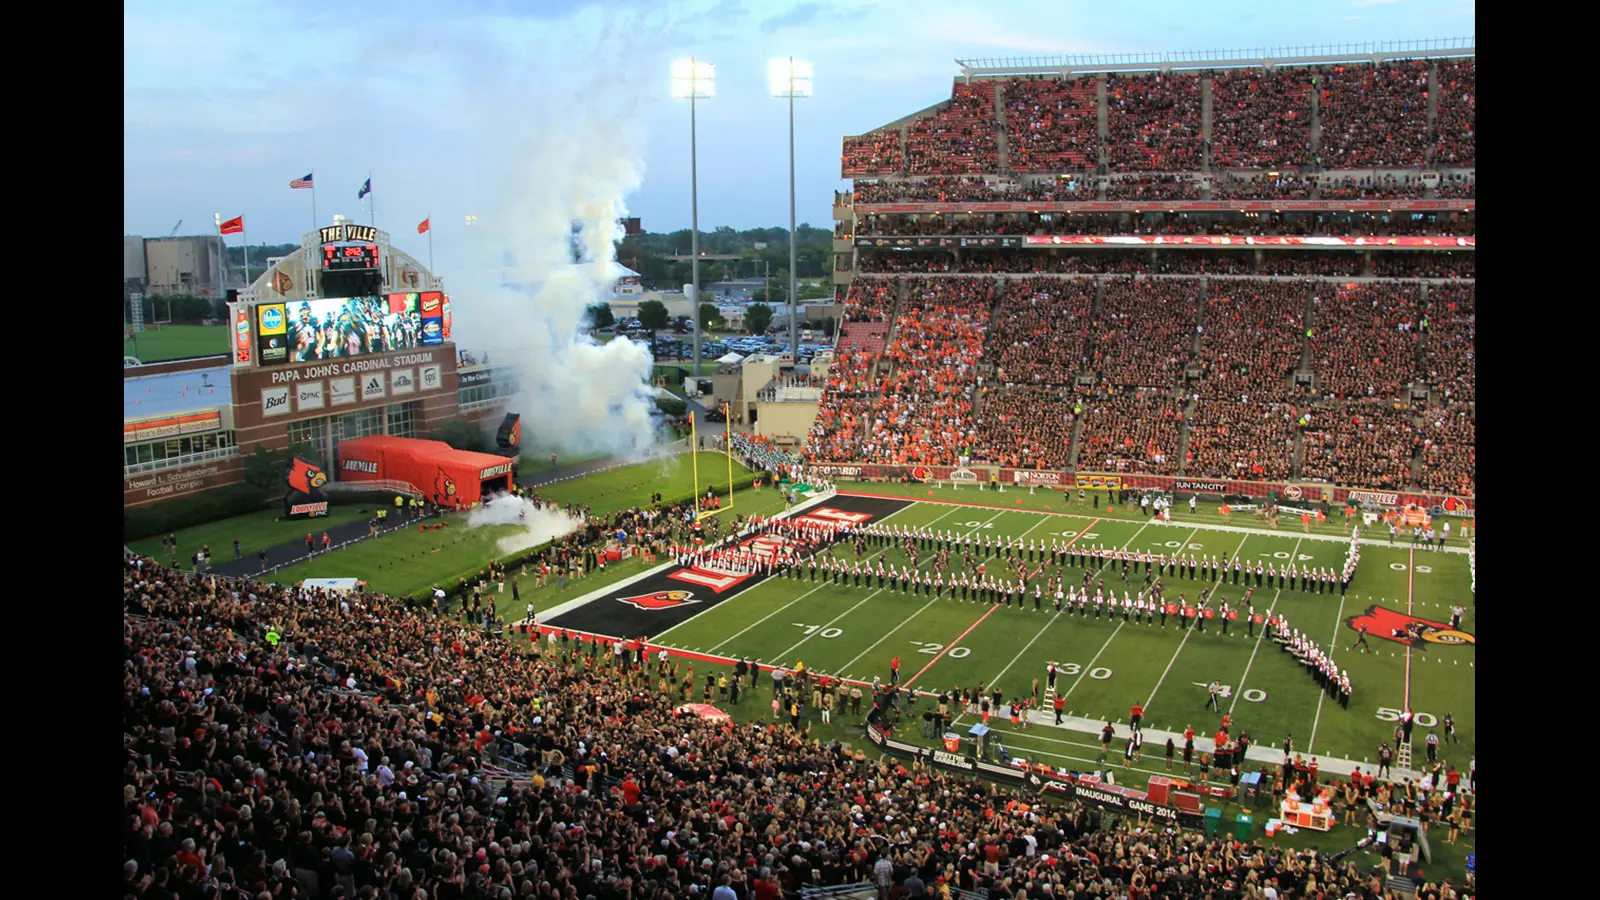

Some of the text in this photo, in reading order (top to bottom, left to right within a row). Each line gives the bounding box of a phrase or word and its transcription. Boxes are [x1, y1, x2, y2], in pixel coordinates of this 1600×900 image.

[321, 225, 377, 242] THE VILLE
[238, 351, 250, 362] 25
[272, 352, 432, 383] PAPA JOHN'S CARDINAL STADIUM
[364, 388, 383, 396] adidas
[265, 392, 288, 410] Bud
[124, 429, 155, 440] merica's
[342, 459, 378, 473] LOUISVILLE
[480, 462, 512, 479] LOUISVILLE
[1030, 471, 1060, 480] NORTON
[128, 478, 157, 489] Howard
[147, 484, 174, 497] Football
[1175, 481, 1190, 489] SUN
[290, 502, 328, 514] LOUISVILLE
[803, 624, 843, 639] 10
[917, 642, 971, 659] 20
[1058, 662, 1113, 680] 30
[1375, 706, 1438, 727] 50
[1045, 780, 1068, 791] ACC
[1076, 786, 1176, 819] INAUGURAL GAME 2014
